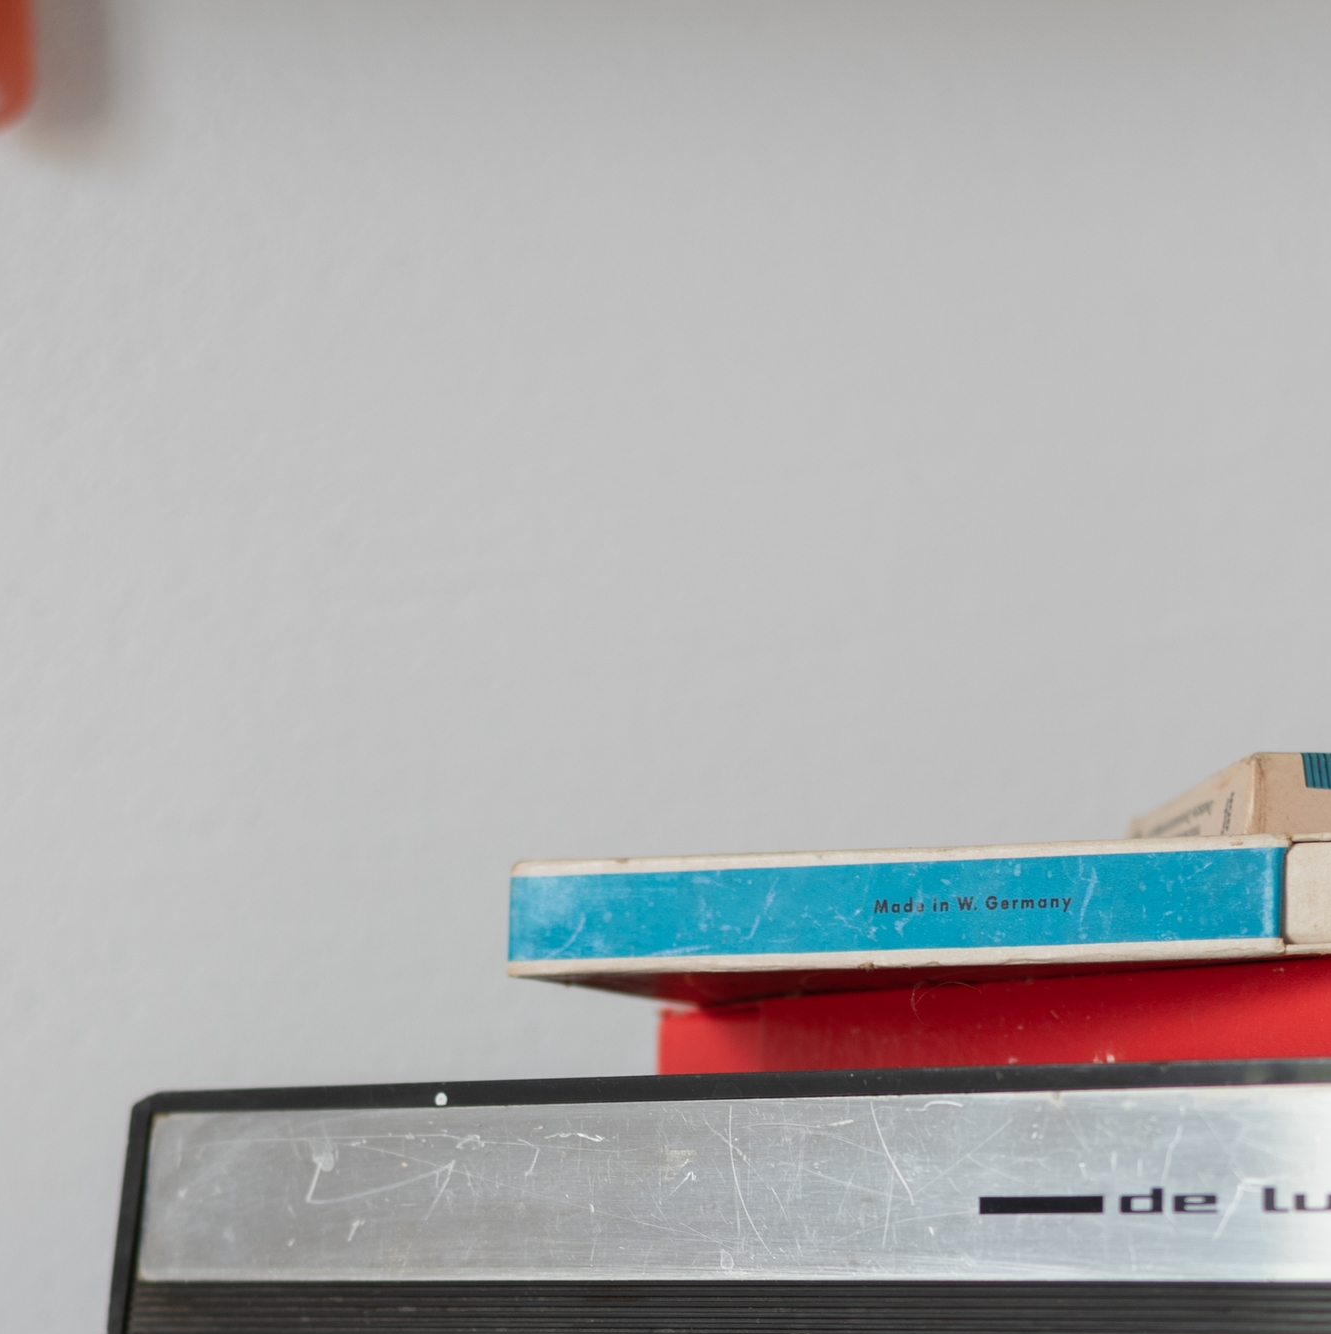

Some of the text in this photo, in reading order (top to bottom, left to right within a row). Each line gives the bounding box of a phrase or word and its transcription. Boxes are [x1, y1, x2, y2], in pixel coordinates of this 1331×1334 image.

[874, 895, 1072, 914] Made in W. Germany
[1119, 1186, 1218, 1214] de
